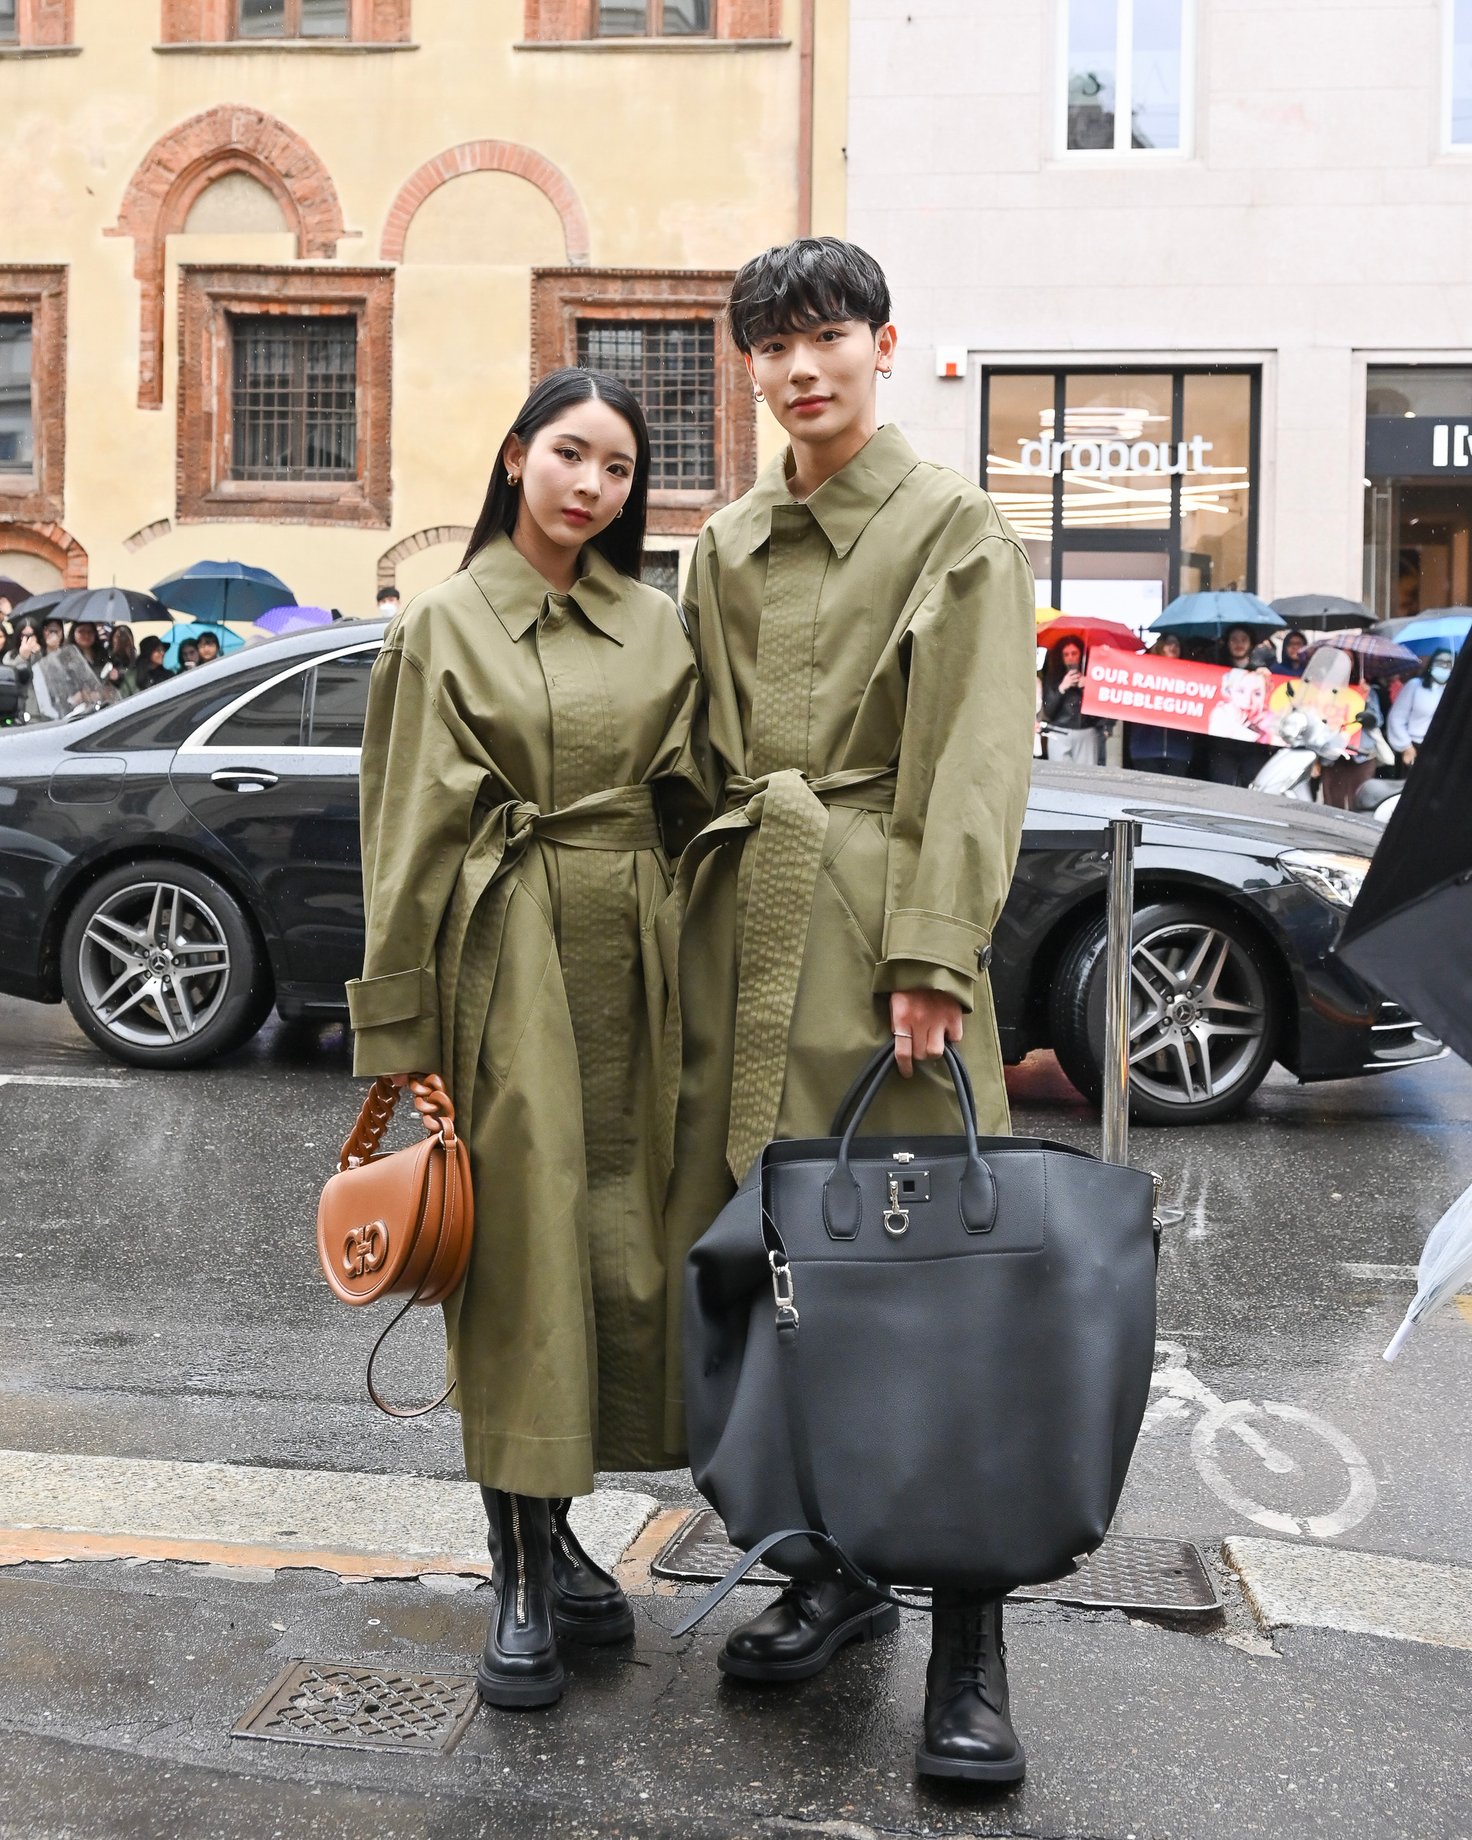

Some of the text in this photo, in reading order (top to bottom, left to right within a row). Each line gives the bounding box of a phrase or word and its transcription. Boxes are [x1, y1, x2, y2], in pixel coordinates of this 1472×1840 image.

[1021, 435, 1213, 480] dropout
[1091, 666, 1217, 699] OUR RAINBOW
[1098, 687, 1204, 717] BUBBLEGUM
